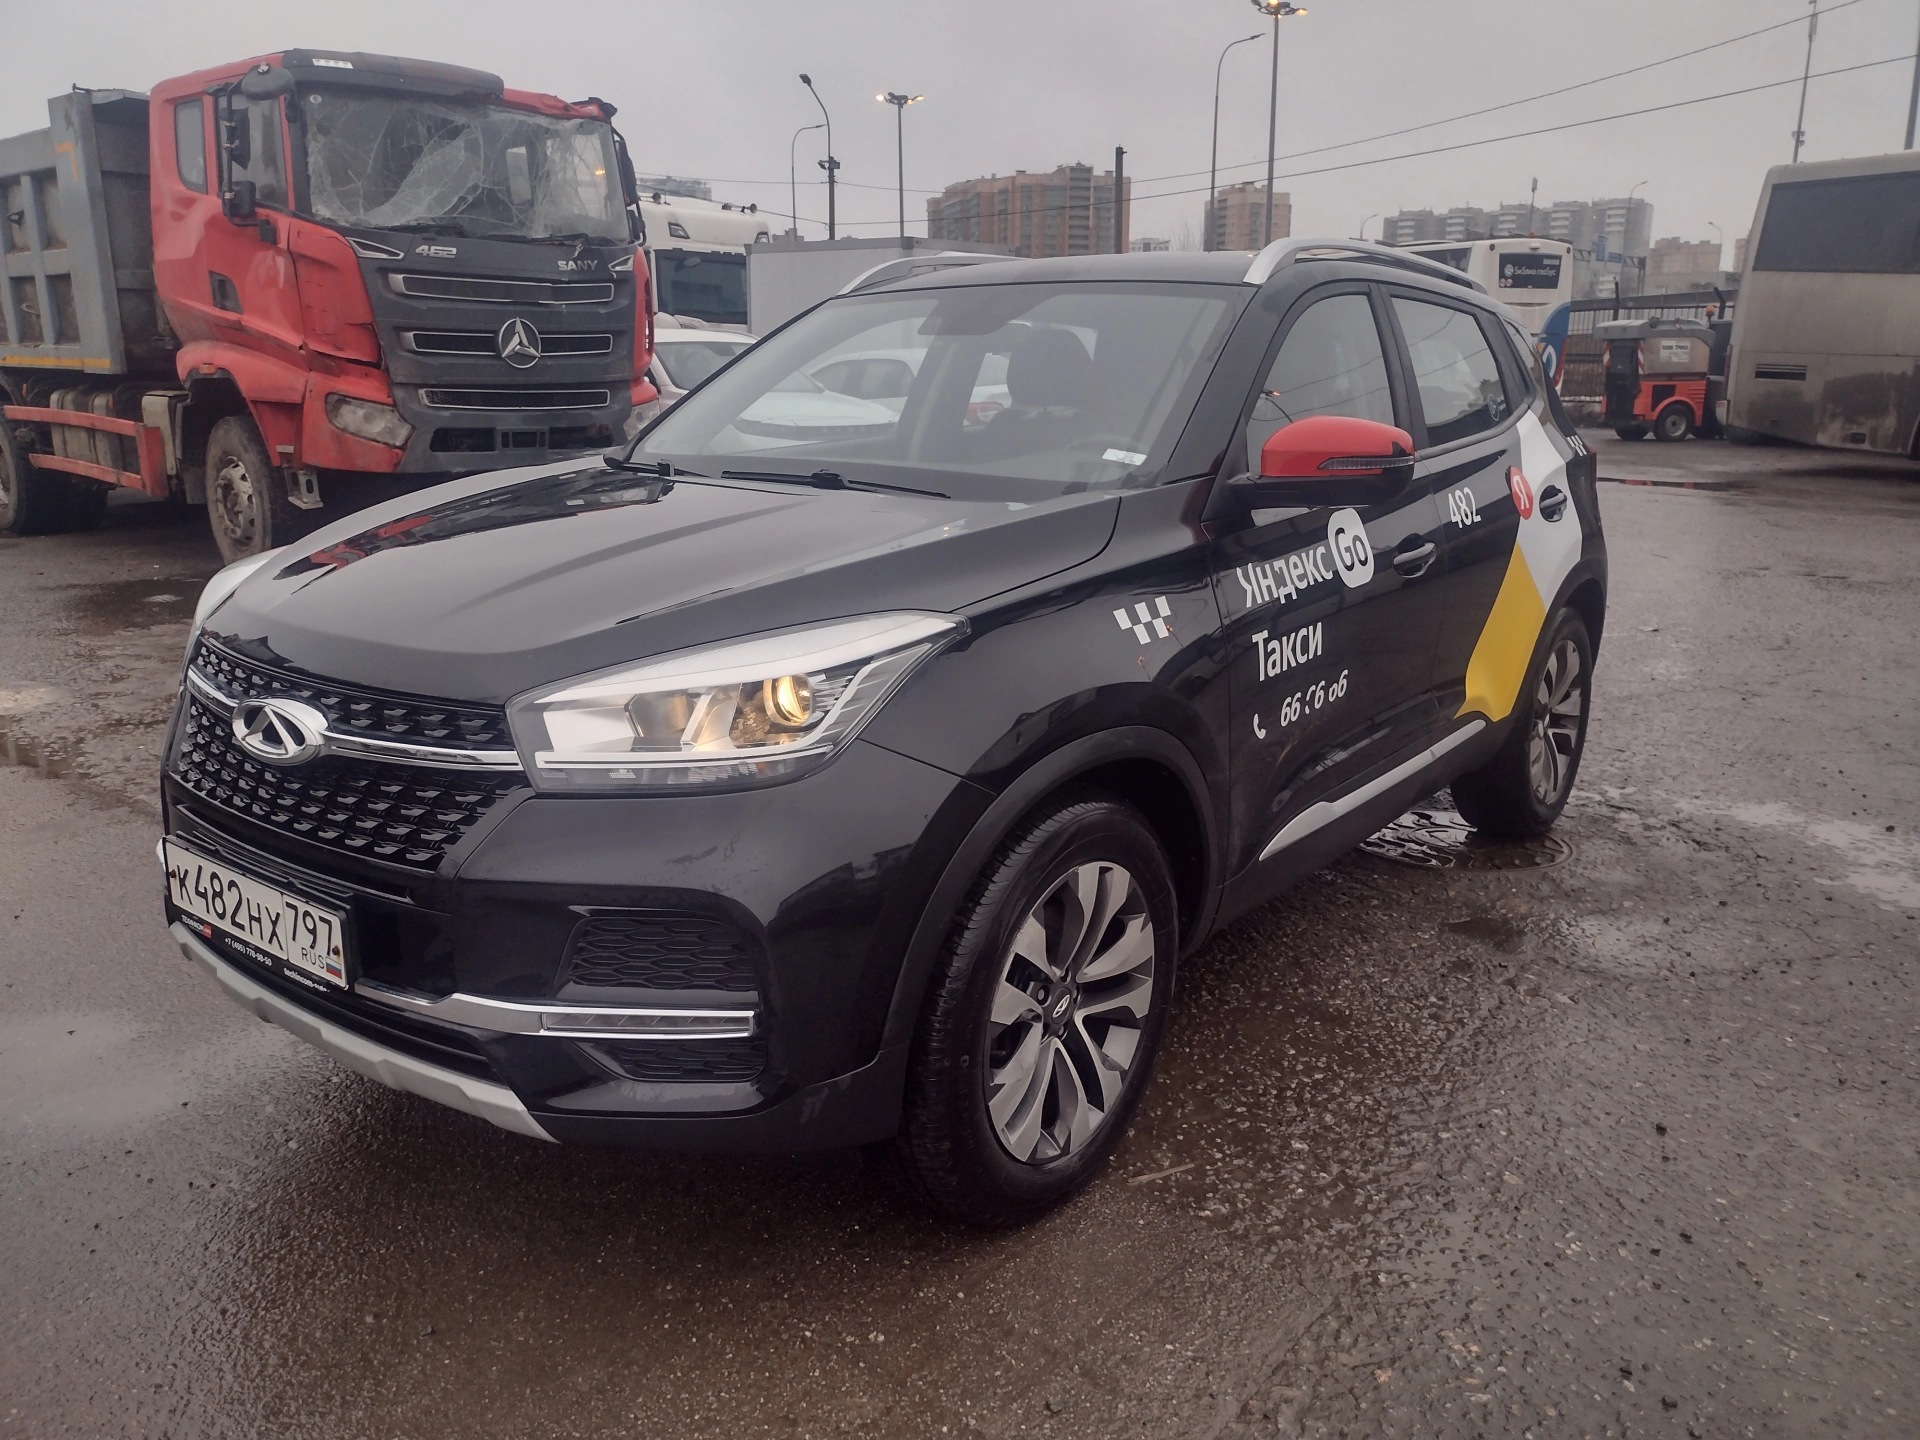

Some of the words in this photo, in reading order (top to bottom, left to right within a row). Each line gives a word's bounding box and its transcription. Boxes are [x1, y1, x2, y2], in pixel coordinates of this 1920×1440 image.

[415, 245, 457, 259] 462
[557, 260, 598, 271] SANY
[1448, 487, 1481, 528] 482
[1513, 475, 1530, 510] Я
[1236, 545, 1334, 608] Яндекс
[1334, 527, 1368, 572] Go
[1252, 621, 1322, 682] Такси
[1280, 692, 1302, 727] 66
[301, 947, 325, 970] RUS
